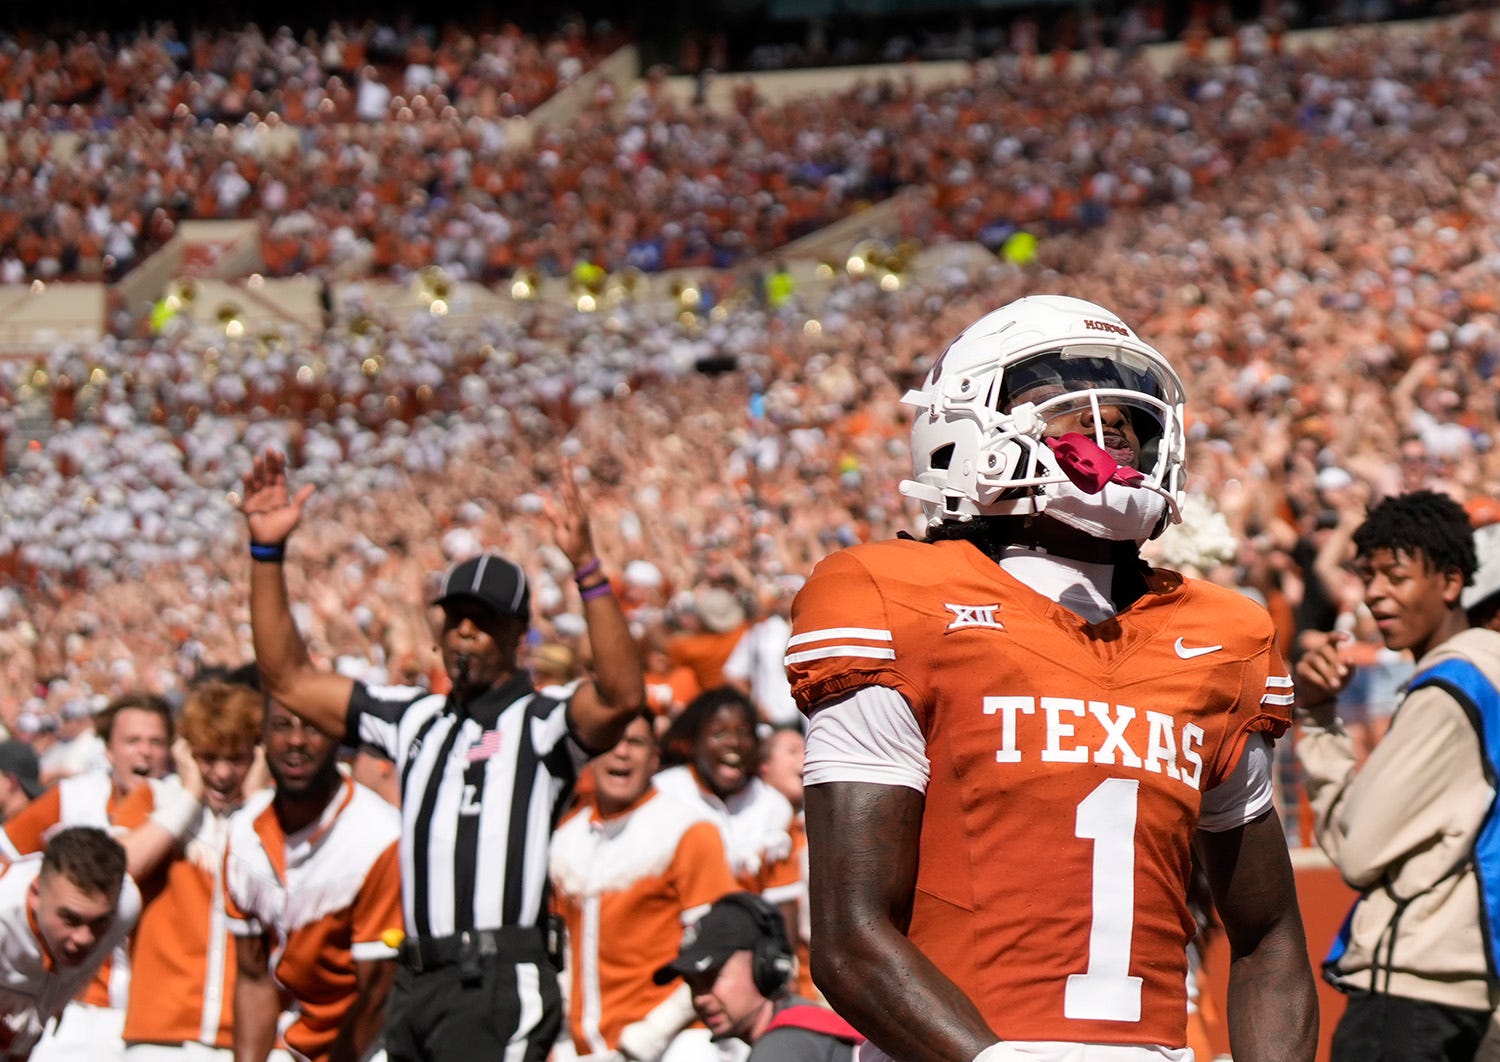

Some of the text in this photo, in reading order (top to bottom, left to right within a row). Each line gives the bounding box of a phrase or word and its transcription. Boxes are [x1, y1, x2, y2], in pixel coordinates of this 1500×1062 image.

[1083, 319, 1130, 337] HORNS
[983, 696, 1204, 790] TEXAS
[1064, 777, 1144, 1022] 1
